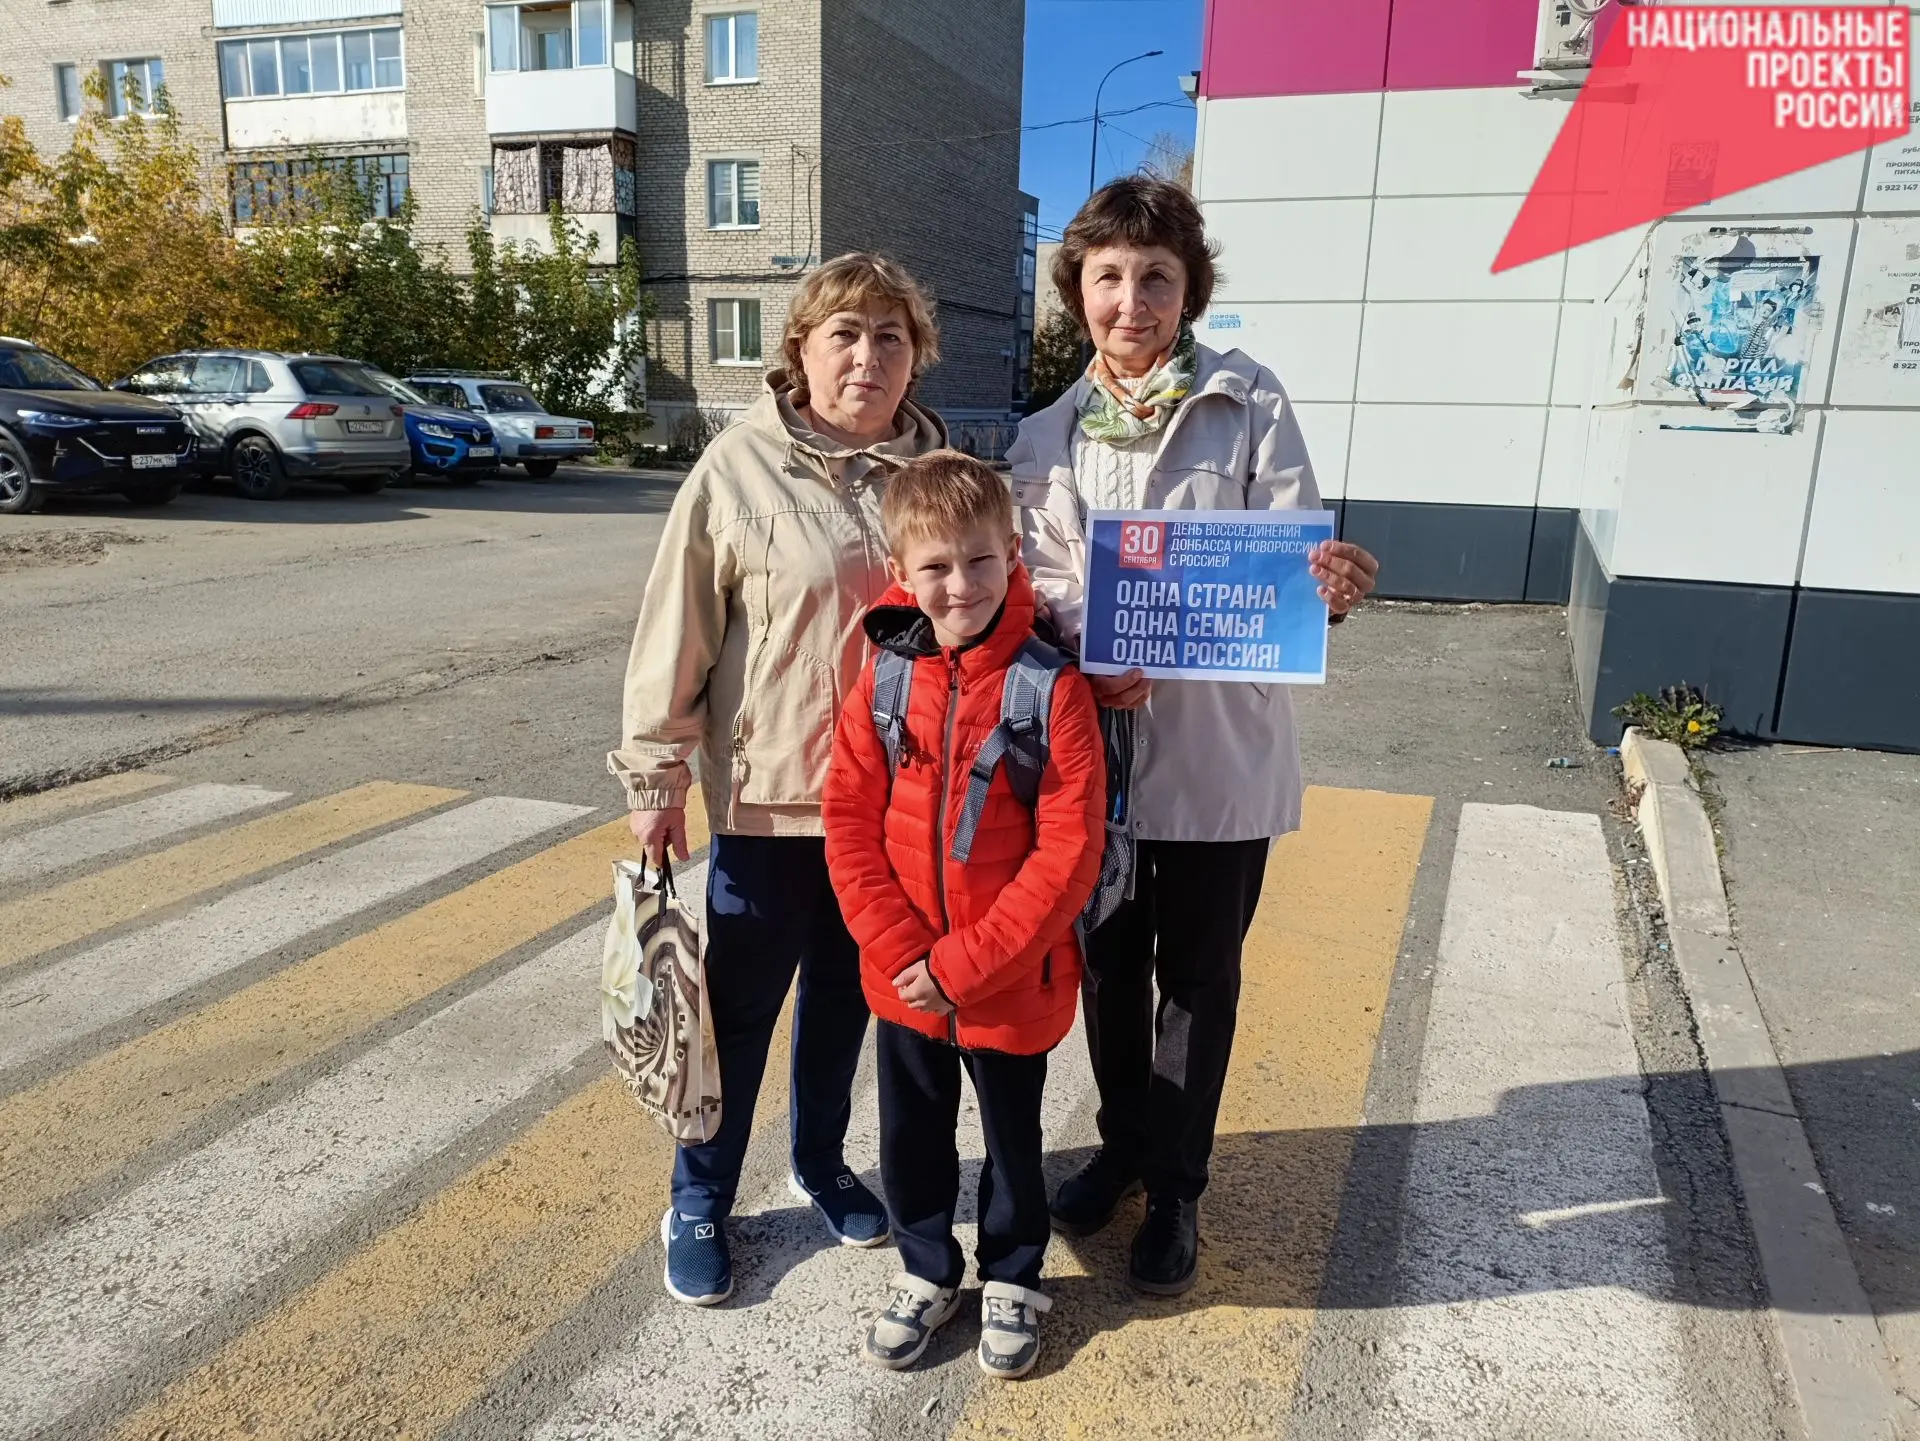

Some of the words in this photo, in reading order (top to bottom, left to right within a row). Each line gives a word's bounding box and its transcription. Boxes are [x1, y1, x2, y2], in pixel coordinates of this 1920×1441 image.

[1124, 525, 1159, 554] 30
[1172, 522, 1202, 537] ДЕНЬ
[1205, 523, 1301, 538] ВОССОЕДИНЕНИЯ
[1170, 538, 1232, 552] ДОНБАССА
[1234, 540, 1243, 553] И
[1245, 540, 1318, 554] НОВОРОССИИ
[1123, 555, 1157, 565] СЕНТЯБРЯ
[1169, 553, 1177, 566] С
[1180, 553, 1230, 568] РОССИЕЙ
[1116, 580, 1180, 608] ОДНА
[1187, 582, 1277, 609] СТРАНА
[1114, 609, 1178, 638] ОДНА
[1185, 612, 1264, 639] СЕМЬЯ
[1112, 638, 1176, 666] ОДНА
[1182, 641, 1281, 669] РОССИЯ!
